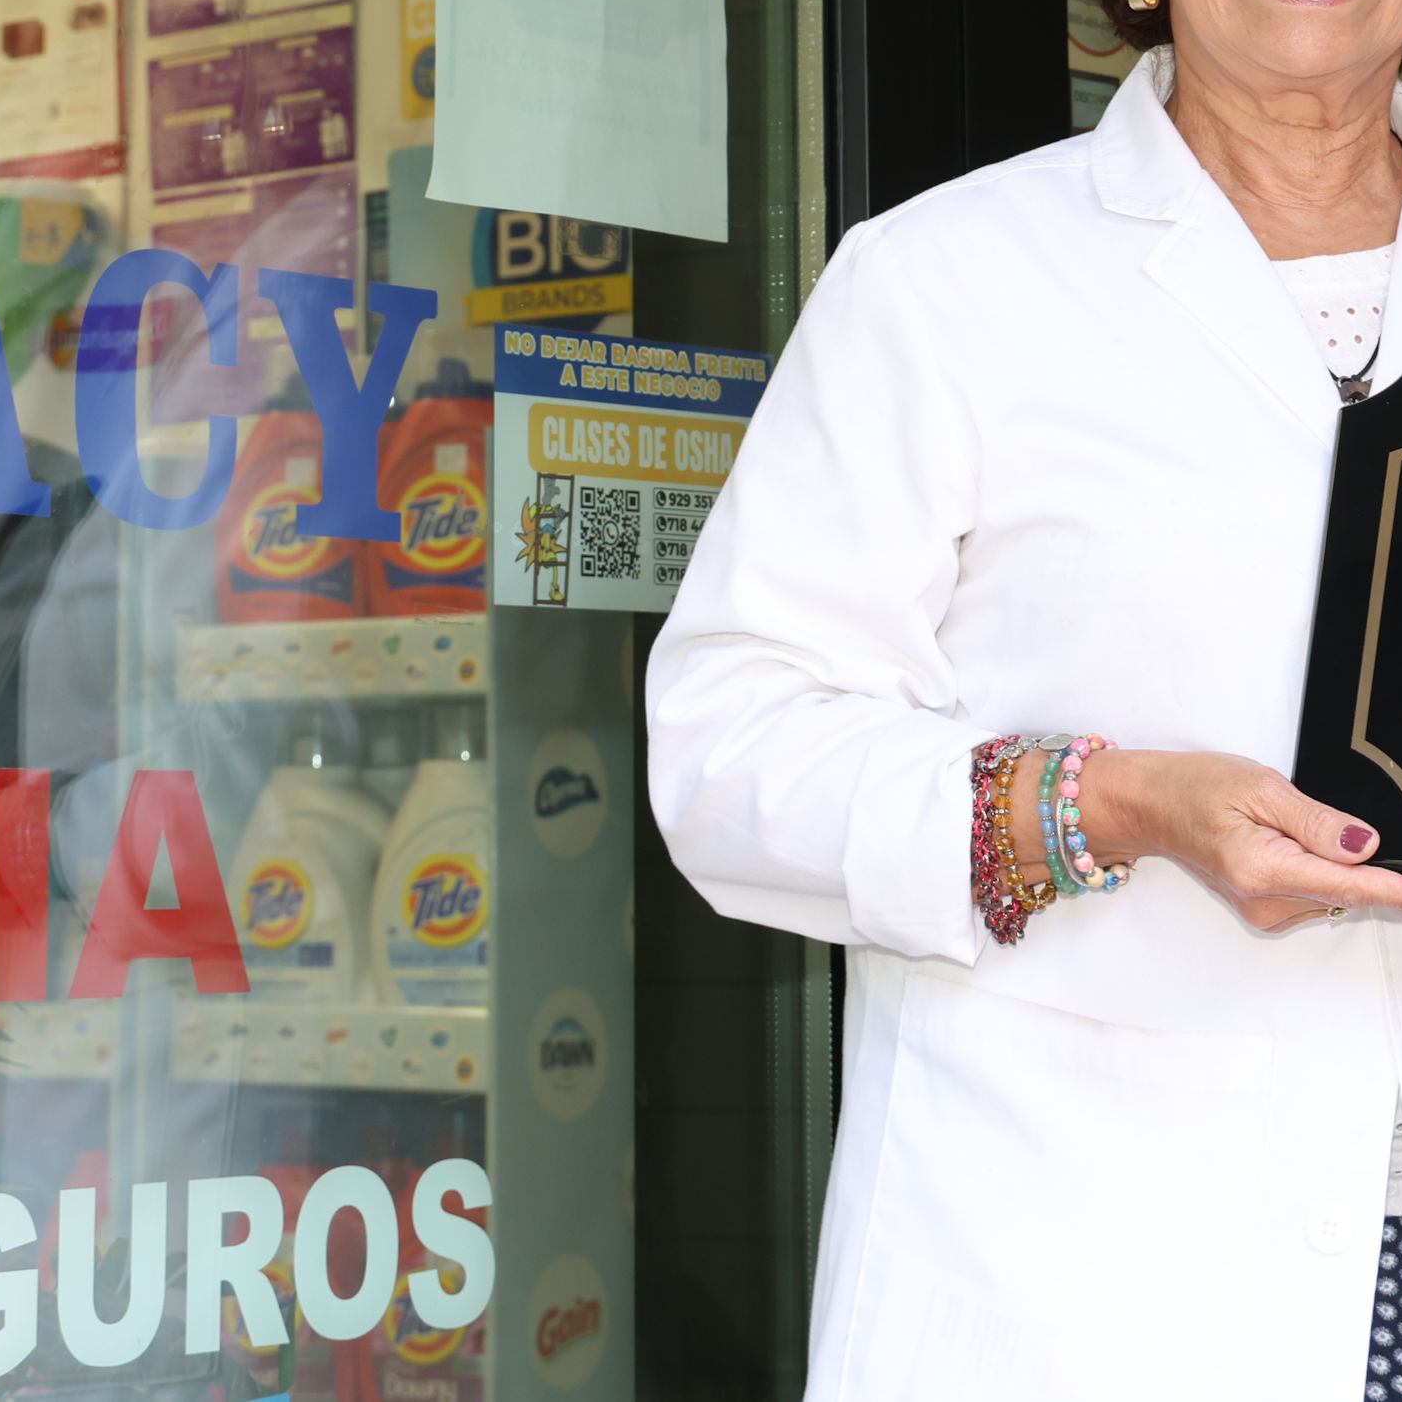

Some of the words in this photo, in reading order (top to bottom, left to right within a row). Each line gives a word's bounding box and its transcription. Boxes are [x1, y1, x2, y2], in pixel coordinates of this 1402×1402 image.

[501, 280, 605, 315] BRANDS
[503, 330, 536, 357] NO
[540, 334, 606, 365] DEJAR
[611, 342, 691, 374] BASURA
[694, 352, 766, 382] FRENTE
[559, 362, 577, 387] A
[581, 365, 629, 392] ESTE
[634, 370, 721, 402] NEGOCIO
[542, 414, 630, 468] CLASES
[637, 423, 666, 470] DE
[674, 427, 733, 476] OSHA
[669, 492, 690, 507] 929
[405, 497, 479, 552] Tide
[667, 517, 687, 531] 718
[667, 542, 687, 557] 718
[248, 877, 305, 931] Tide
[412, 872, 483, 929] Tide
[540, 1038, 596, 1073] DAWN
[537, 1296, 601, 1359] Gain
